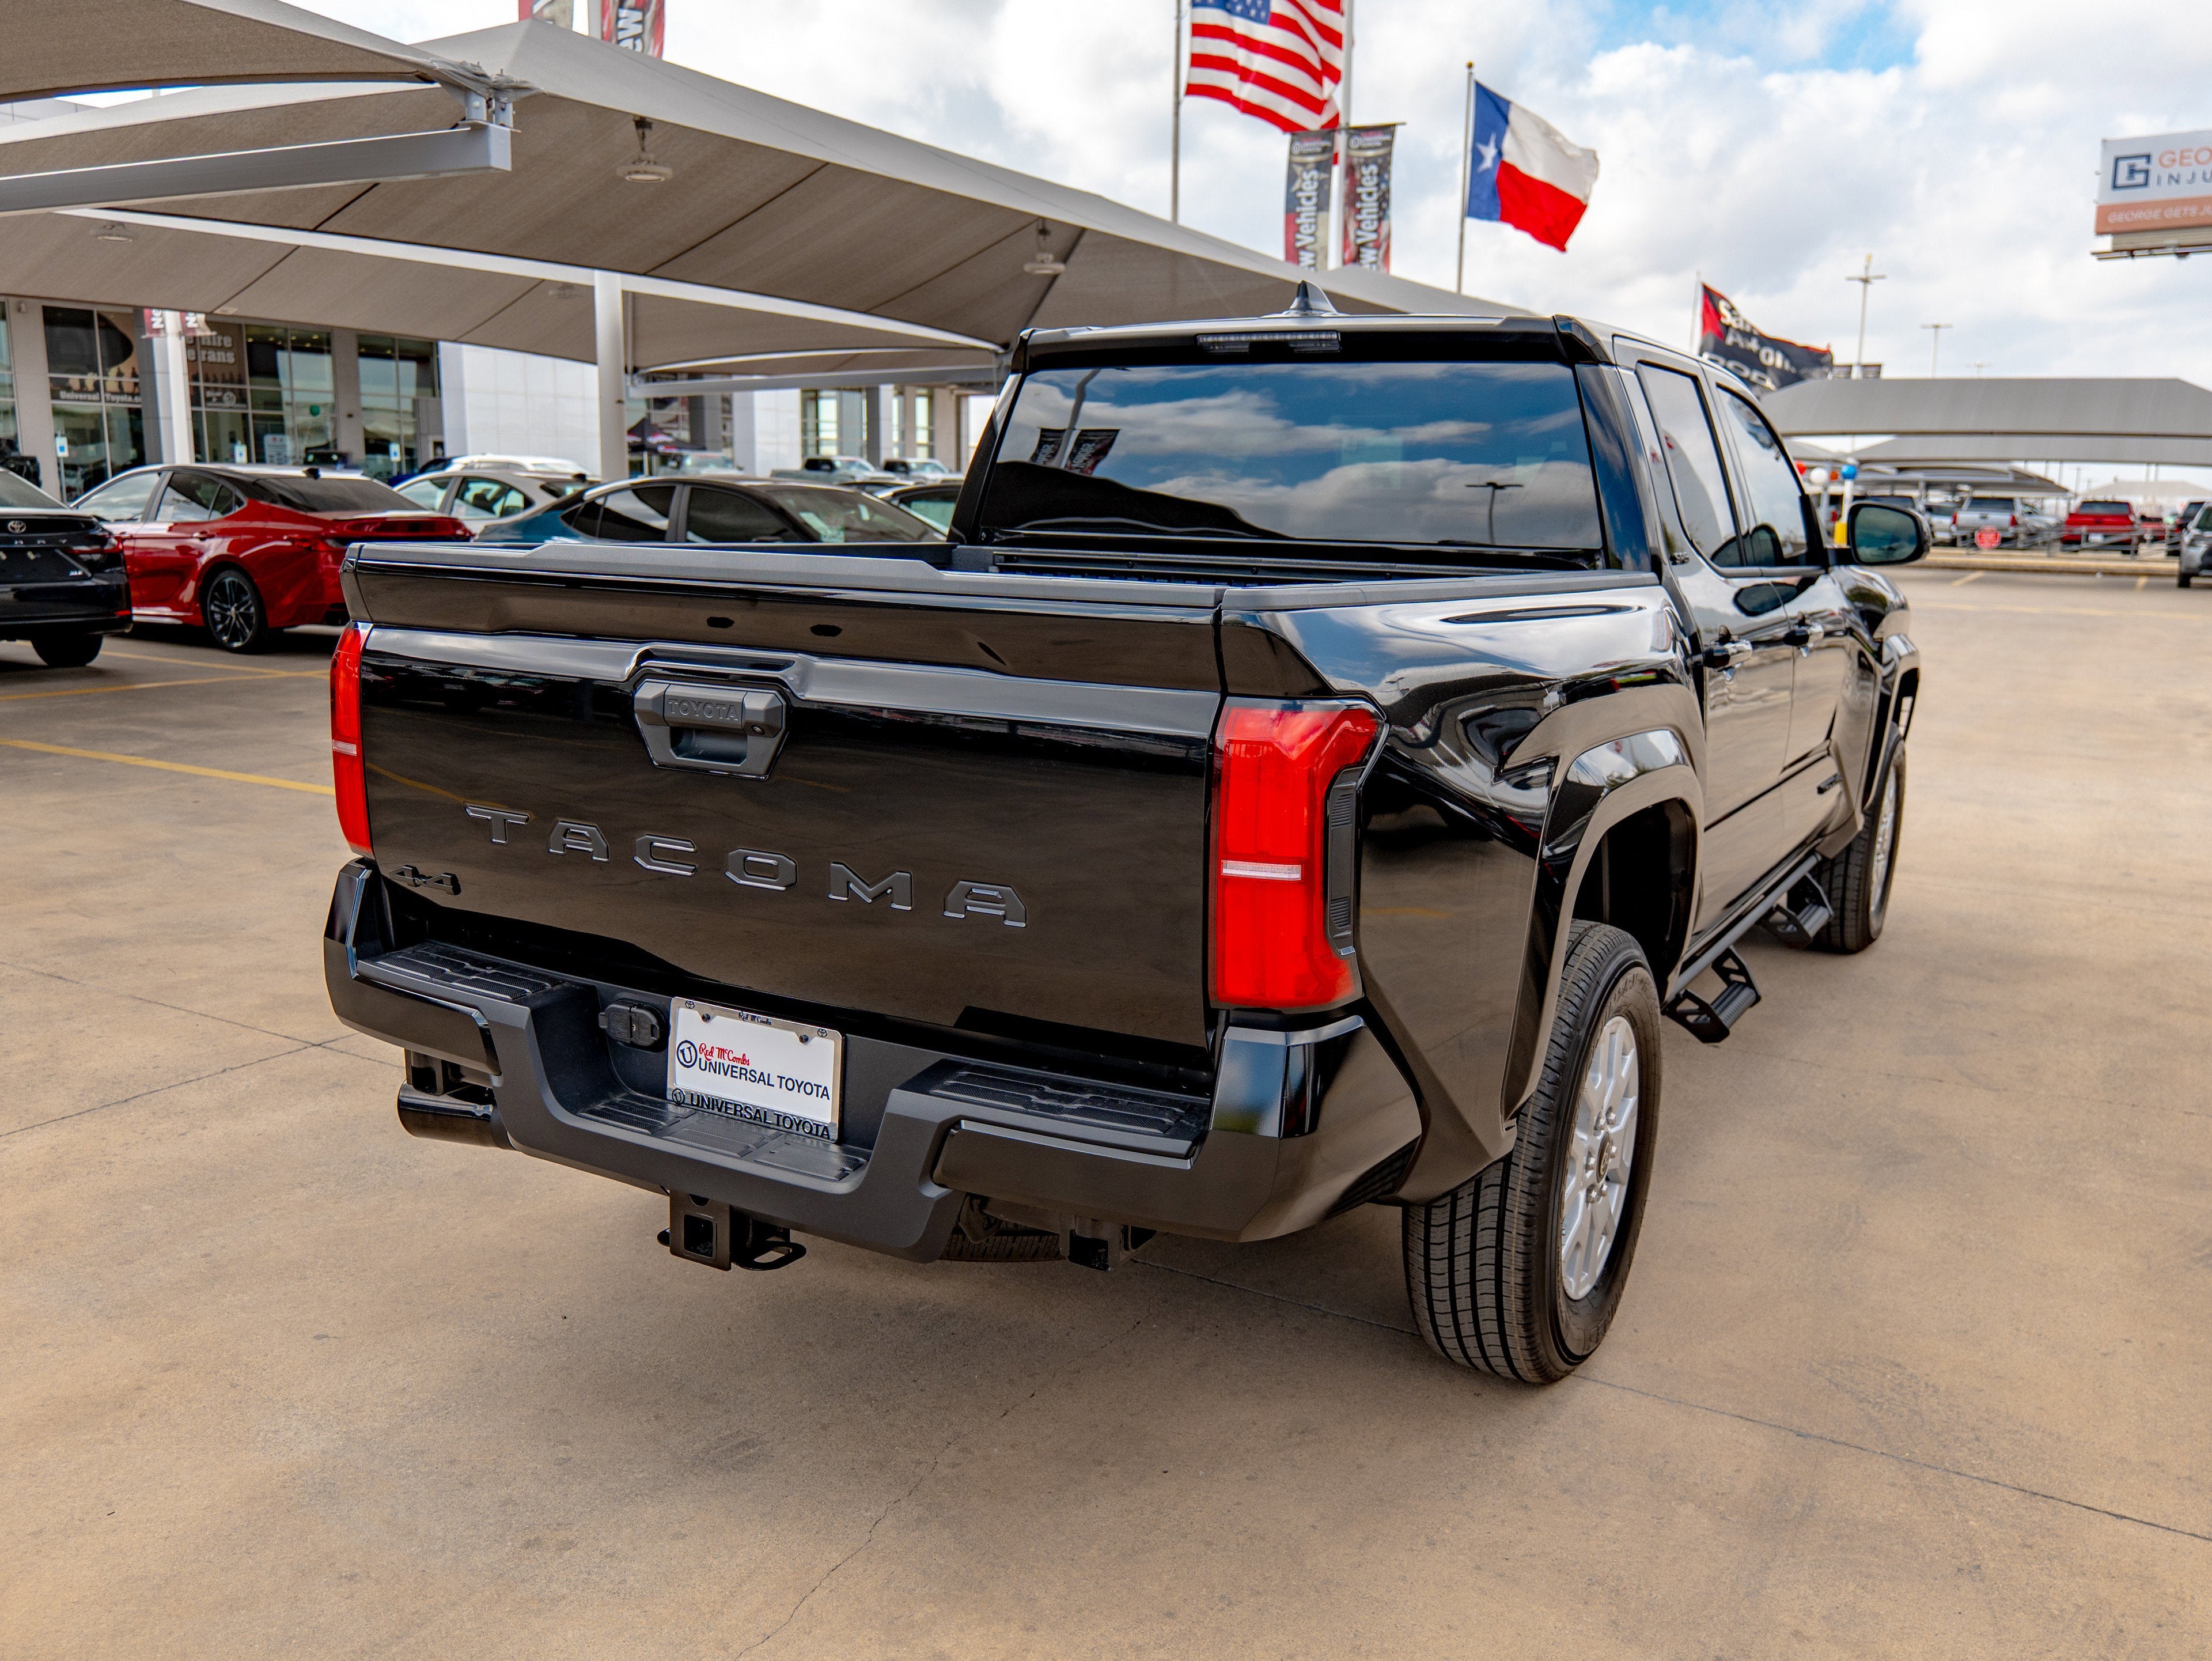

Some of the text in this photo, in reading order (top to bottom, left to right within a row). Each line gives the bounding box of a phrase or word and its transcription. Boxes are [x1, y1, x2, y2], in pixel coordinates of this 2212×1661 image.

[1294, 168, 1320, 248] Vehicles
[1354, 164, 1380, 245] Vehicles
[668, 698, 738, 721] TOYOTA
[464, 802, 1029, 928] TACOMA
[699, 1043, 750, 1066] Red McCombs
[699, 1058, 831, 1101] UNIVERSAL TOYOTA
[691, 1092, 773, 1124] UNIVERSAL
[774, 1111, 831, 1140] TOYOTA
